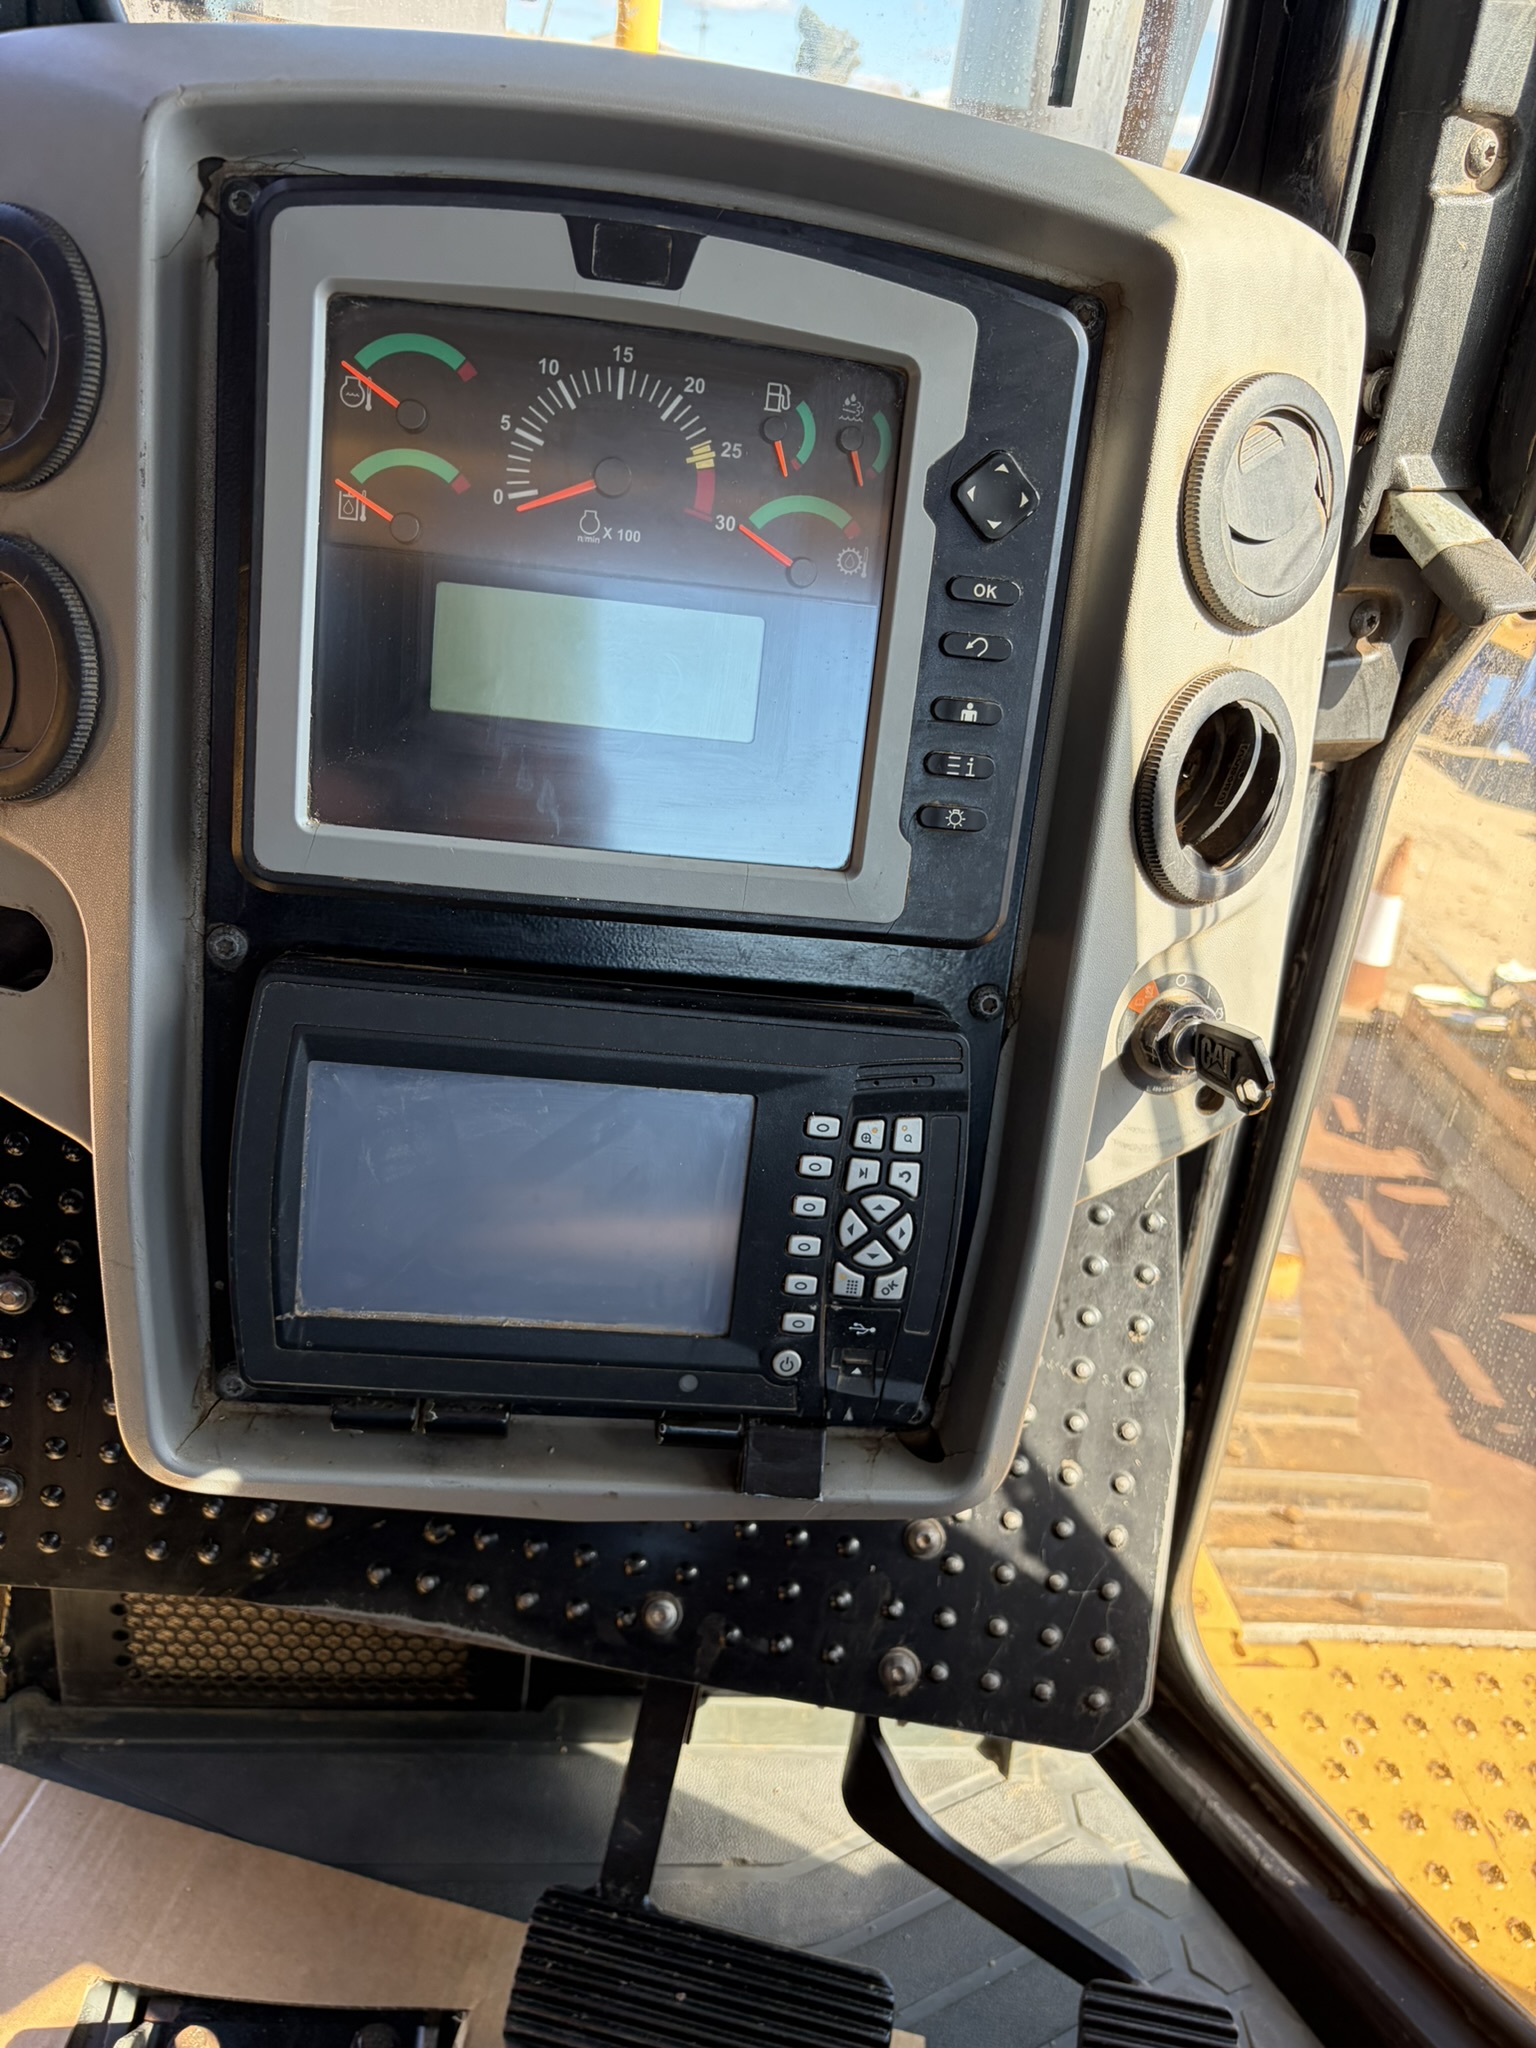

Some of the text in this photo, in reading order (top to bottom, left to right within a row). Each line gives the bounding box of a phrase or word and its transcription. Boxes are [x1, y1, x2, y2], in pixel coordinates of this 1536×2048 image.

[612, 345, 634, 363] 15
[538, 357, 560, 376] 10
[684, 376, 706, 394] 20
[500, 414, 511, 431] 5
[720, 441, 743, 459] 25
[493, 488, 504, 505] 0
[715, 515, 736, 532] 30
[617, 528, 641, 543] 100
[973, 583, 998, 599] OK
[1200, 1036, 1237, 1081] CAT
[881, 1280, 899, 1296] OK
